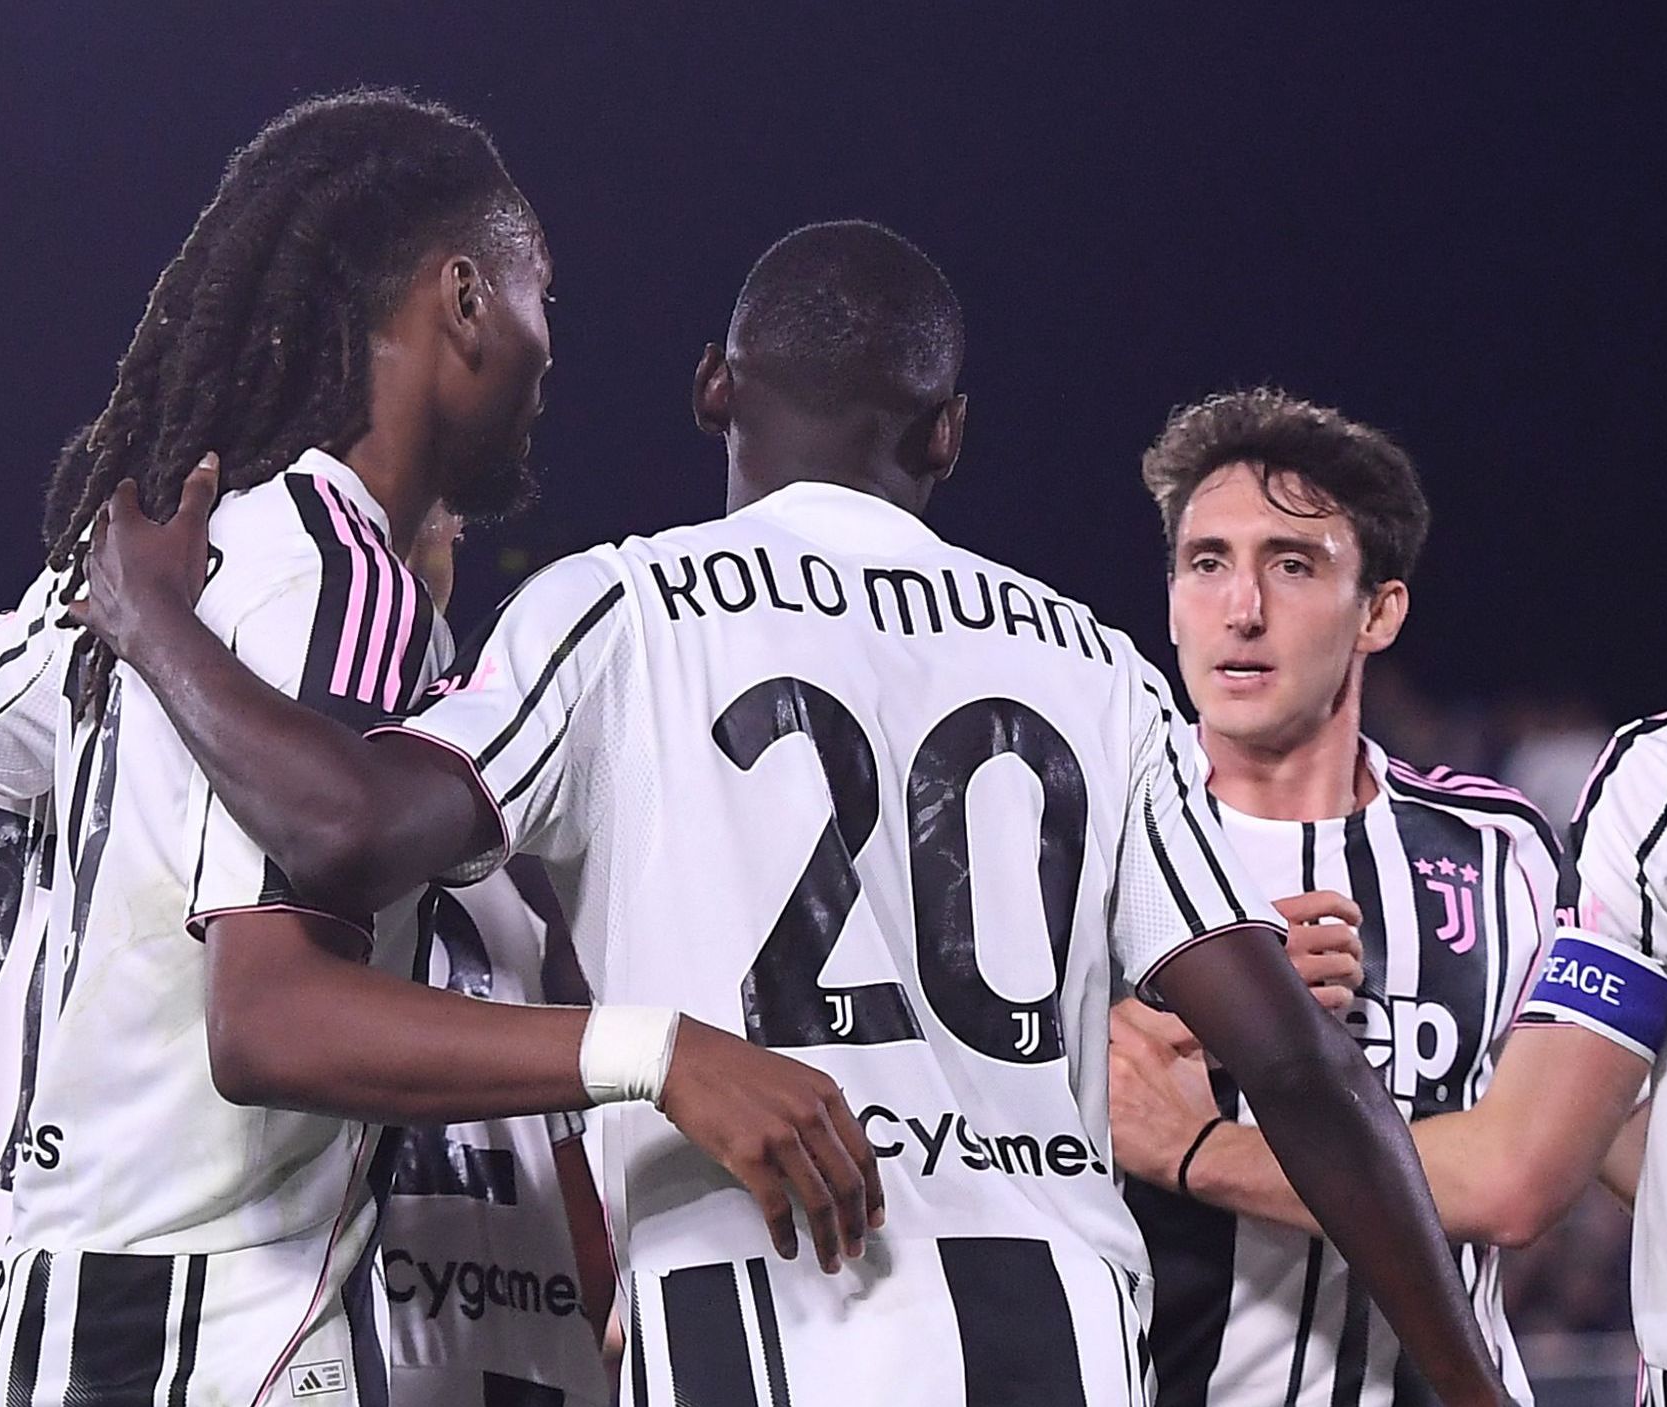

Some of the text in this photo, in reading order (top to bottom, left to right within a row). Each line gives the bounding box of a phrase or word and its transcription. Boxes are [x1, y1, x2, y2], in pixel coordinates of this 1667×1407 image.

[649, 550, 1114, 666] KOLO MUANI
[712, 676, 1089, 1065] 20
[384, 1248, 586, 1322] Cygame
